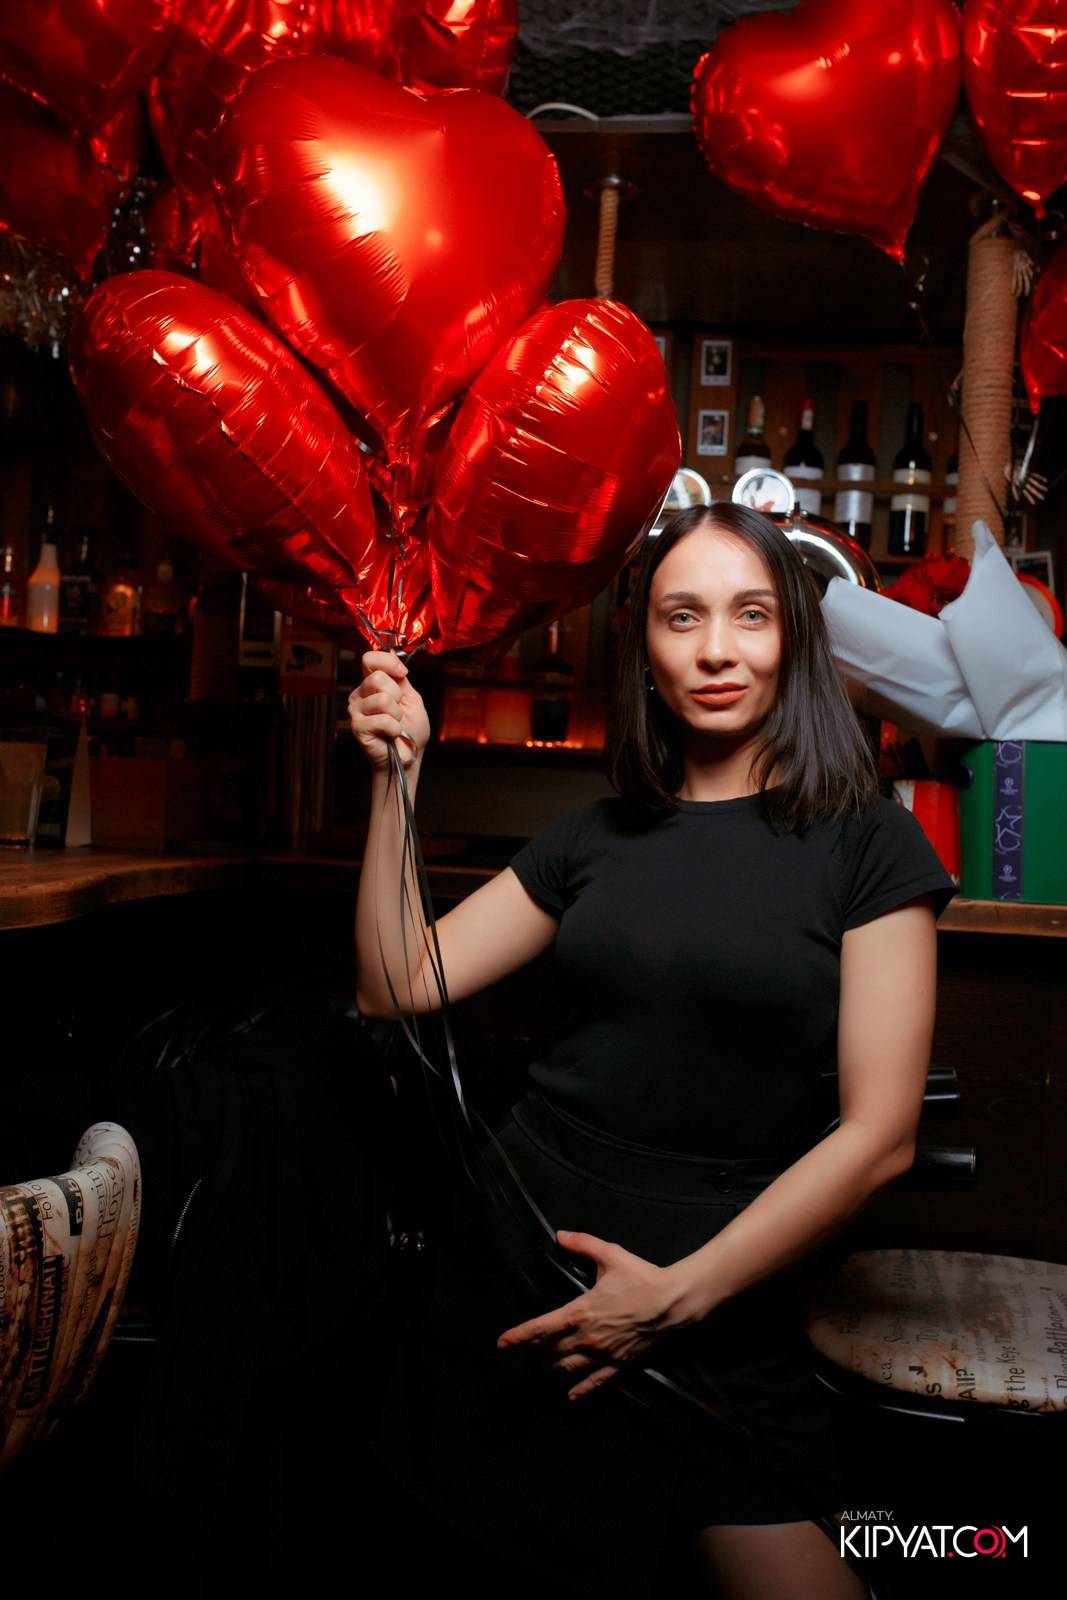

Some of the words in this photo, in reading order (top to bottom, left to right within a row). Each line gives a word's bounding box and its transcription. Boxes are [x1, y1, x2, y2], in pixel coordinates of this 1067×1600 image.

[995, 1345, 1020, 1366] Keys
[954, 1368, 977, 1401] All?
[1004, 1367, 1026, 1392] the
